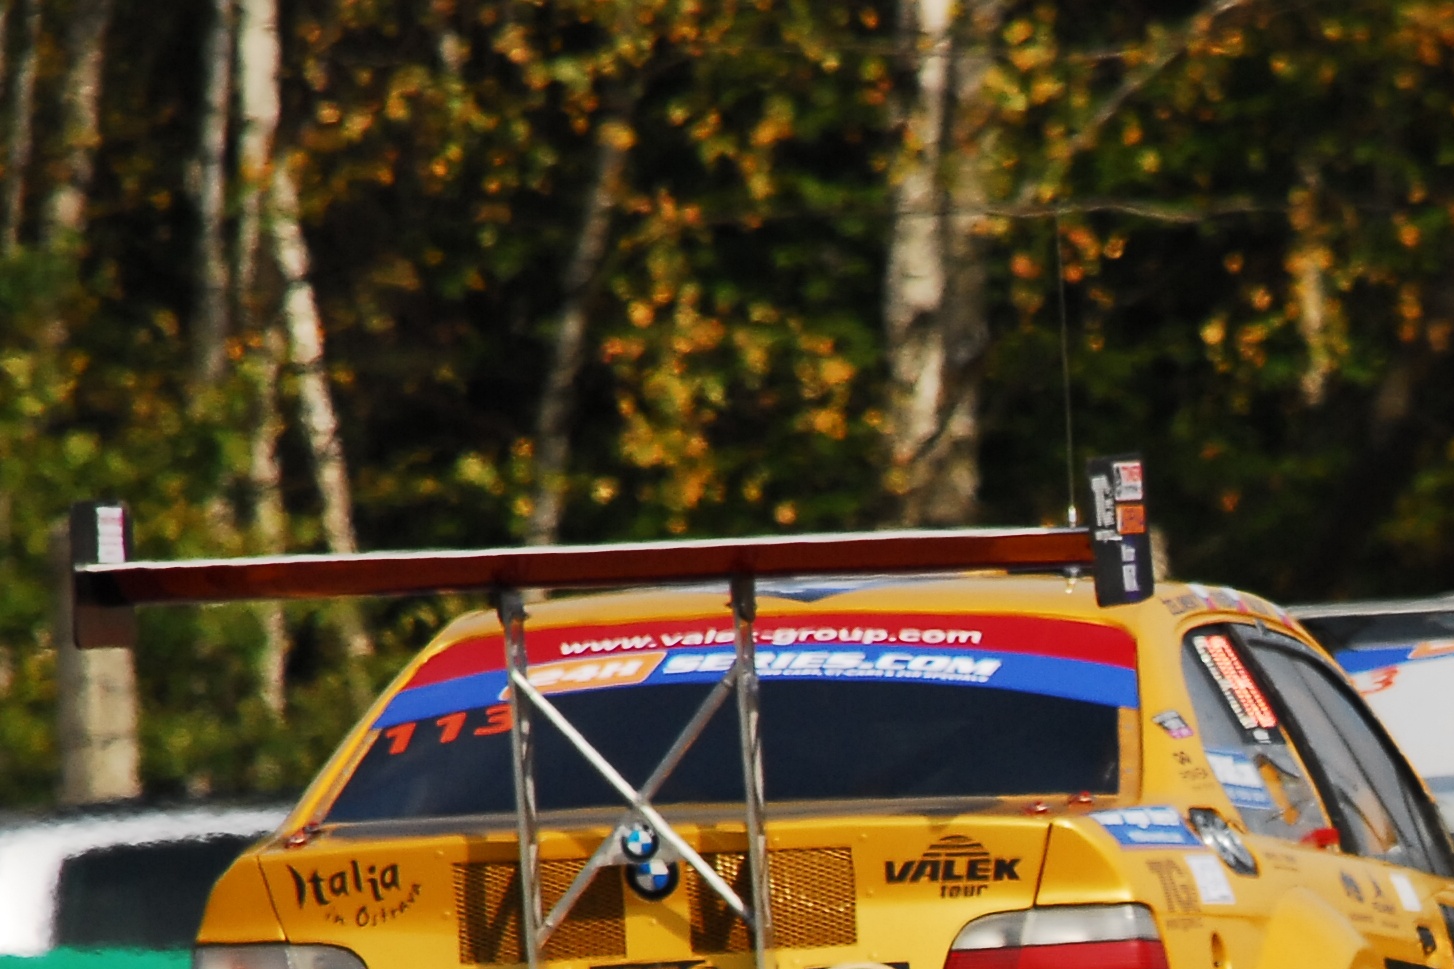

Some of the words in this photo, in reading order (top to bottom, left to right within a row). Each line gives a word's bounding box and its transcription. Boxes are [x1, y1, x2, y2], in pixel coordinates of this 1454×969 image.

[560, 626, 983, 656] www.vale-group.com
[385, 704, 515, 755] 113
[286, 860, 401, 909] Italia
